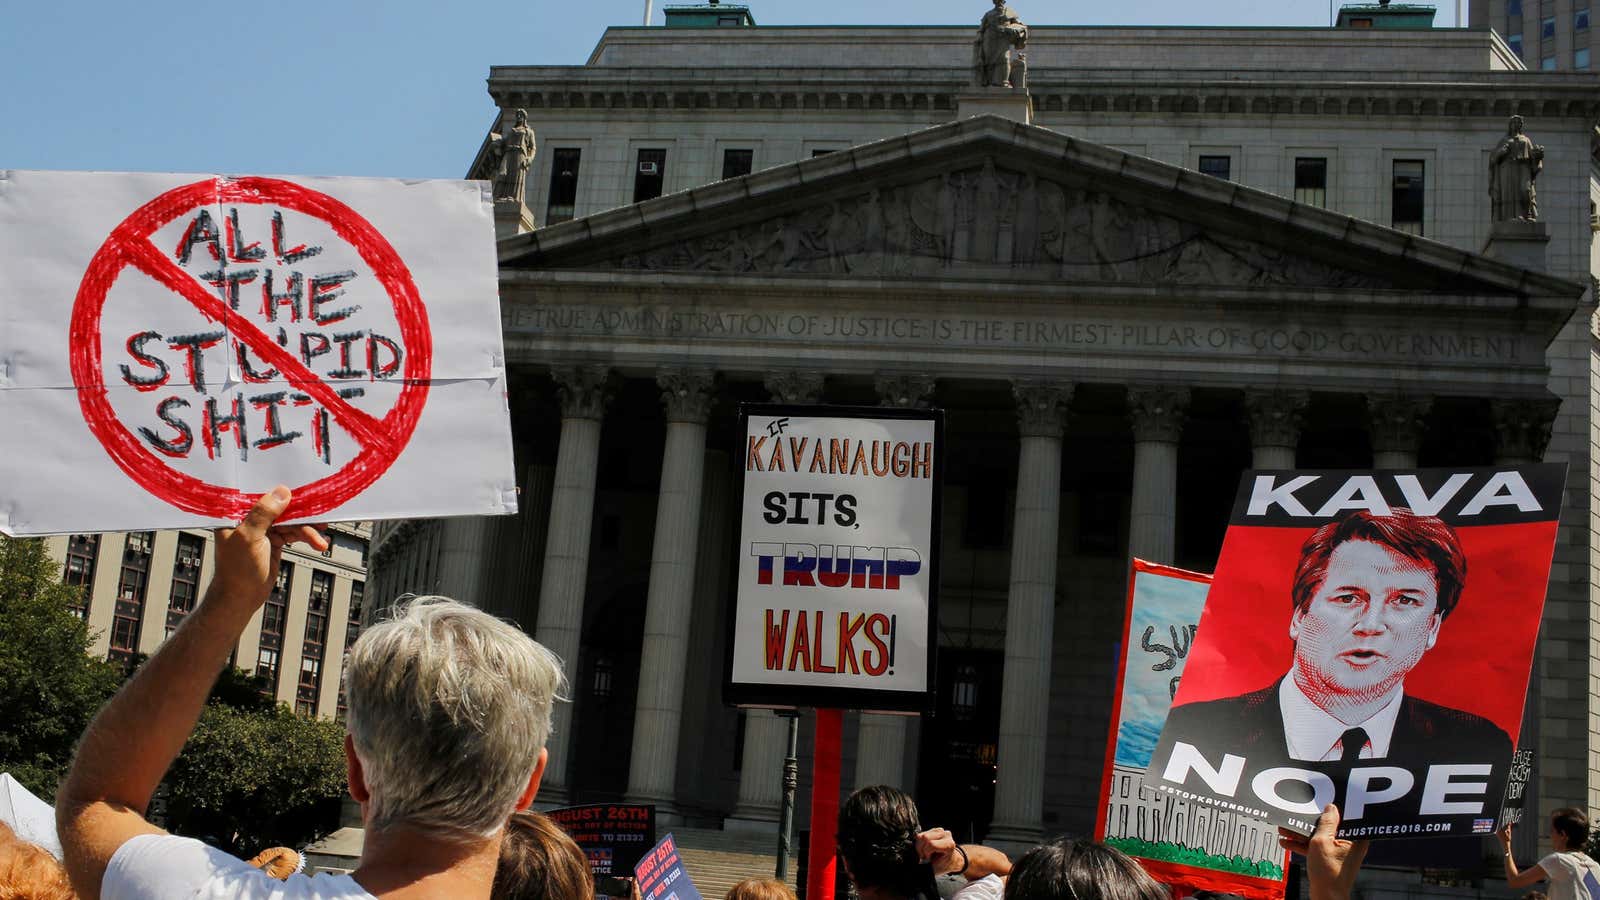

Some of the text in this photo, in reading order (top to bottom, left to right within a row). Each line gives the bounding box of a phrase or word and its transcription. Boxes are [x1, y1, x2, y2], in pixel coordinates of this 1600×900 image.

[175, 208, 323, 266] ALL
[199, 269, 362, 326] THE
[502, 309, 1519, 360] HE TRUE ADMINISTRATION OF JUSTICE IS THE FIRMEST PILLAR OF GOOD GOVERNMENT
[119, 327, 404, 394] STUPID
[137, 387, 365, 466] SHIT
[766, 418, 790, 437] IF
[746, 434, 933, 479] KAVANAUGH
[763, 490, 860, 530] SITS,
[1246, 471, 1544, 517] KAVA
[751, 541, 921, 590] TRUMP
[764, 608, 897, 677] WALKS!
[1159, 785, 1269, 818] #STOPKAVANAUGH
[1163, 741, 1493, 821] NOPE
[602, 833, 613, 841] TO
[608, 807, 649, 820] 26TH
